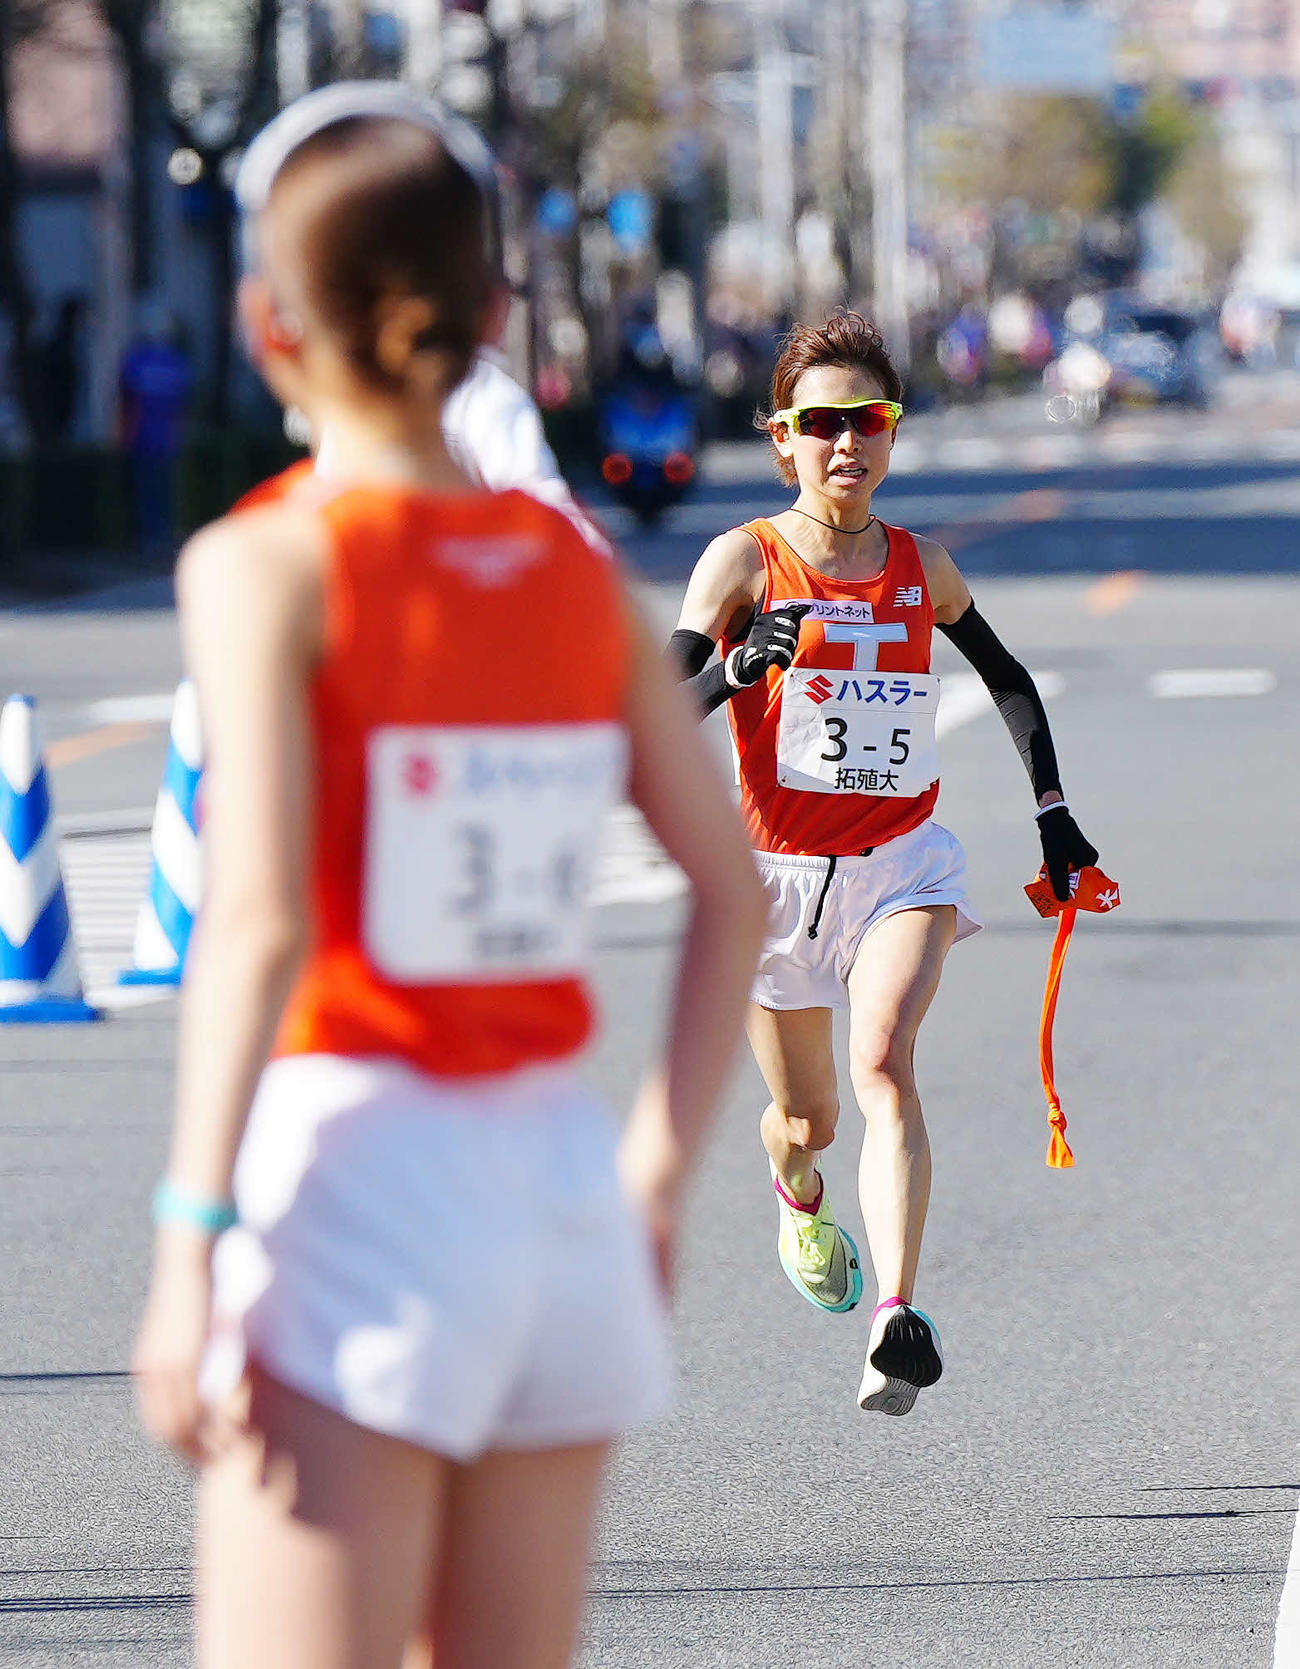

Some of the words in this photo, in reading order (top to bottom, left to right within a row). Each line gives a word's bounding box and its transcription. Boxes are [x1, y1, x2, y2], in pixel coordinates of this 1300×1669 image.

[836, 679, 927, 706] ハスラー
[834, 767, 899, 791] 拓殖大
